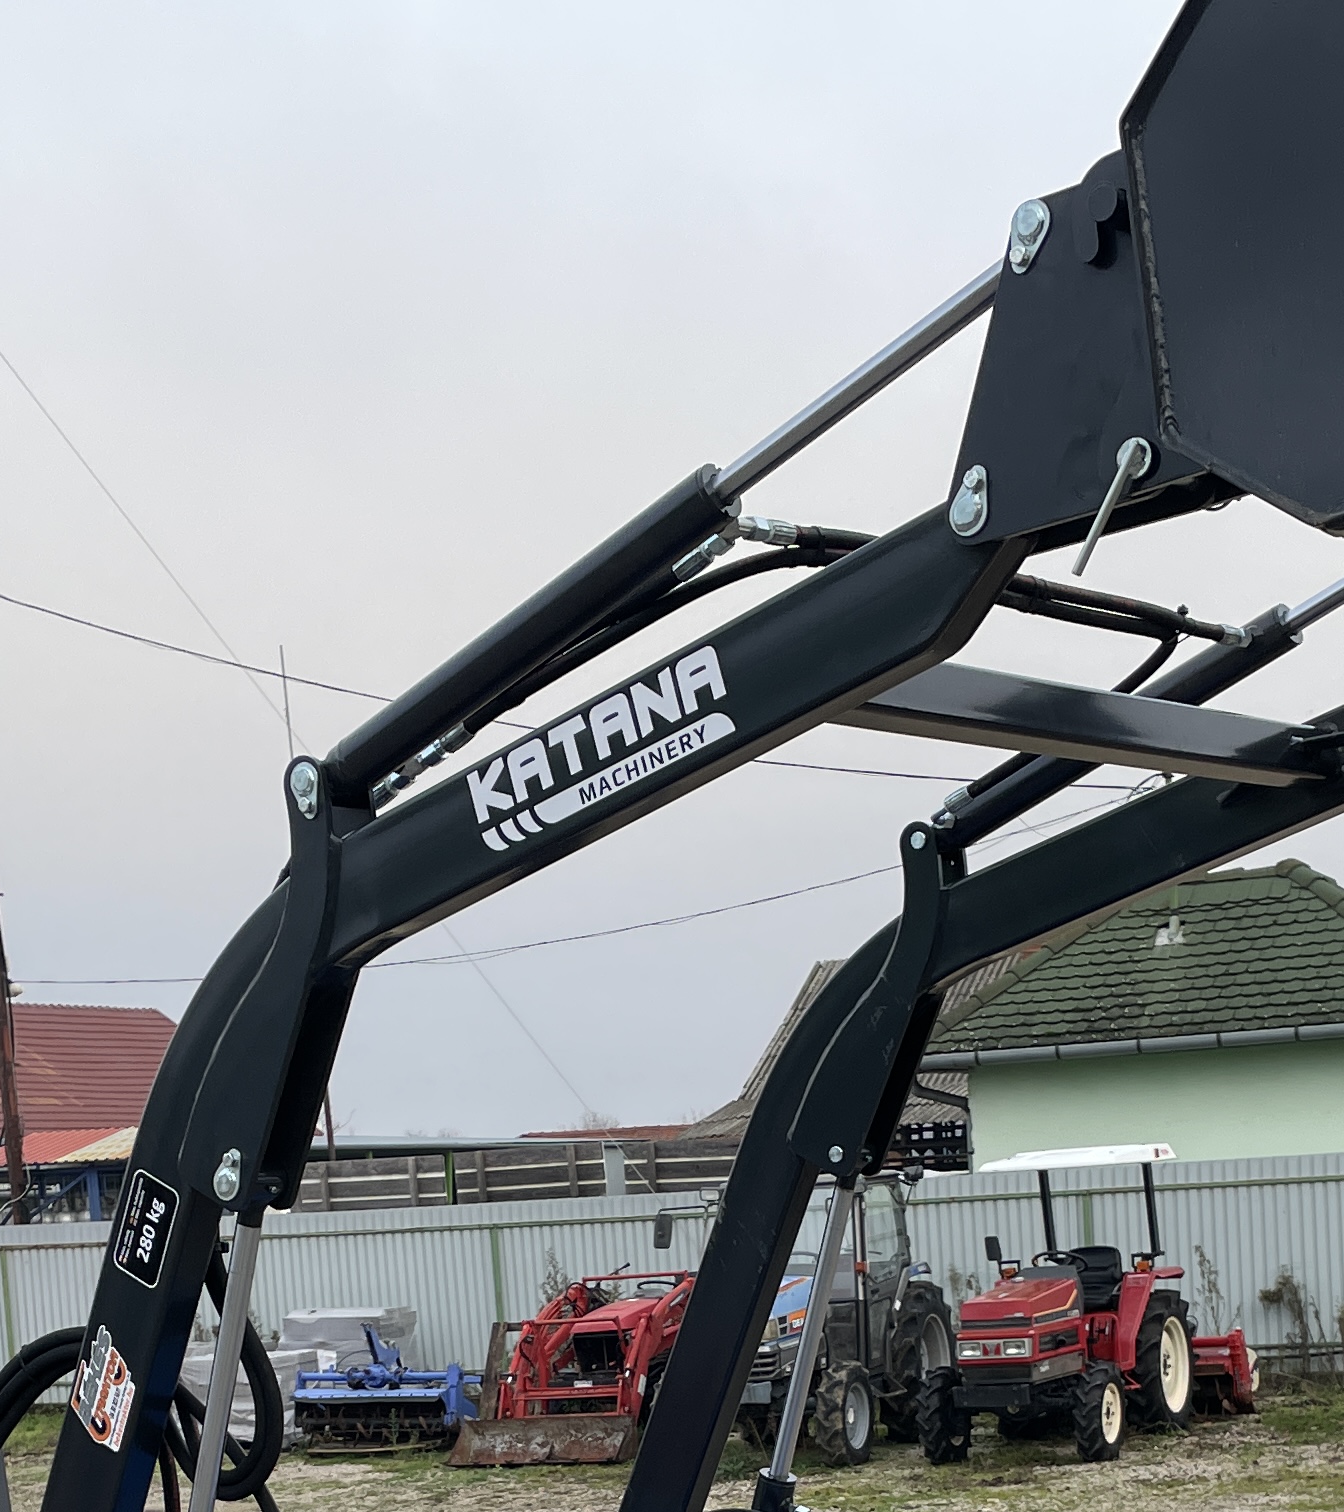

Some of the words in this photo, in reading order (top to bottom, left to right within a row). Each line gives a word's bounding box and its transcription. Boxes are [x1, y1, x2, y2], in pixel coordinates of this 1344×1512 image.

[466, 645, 727, 824] KATANA
[578, 724, 706, 805] MACHINERY
[145, 1197, 166, 1224] kg
[136, 1224, 156, 1264] 280
